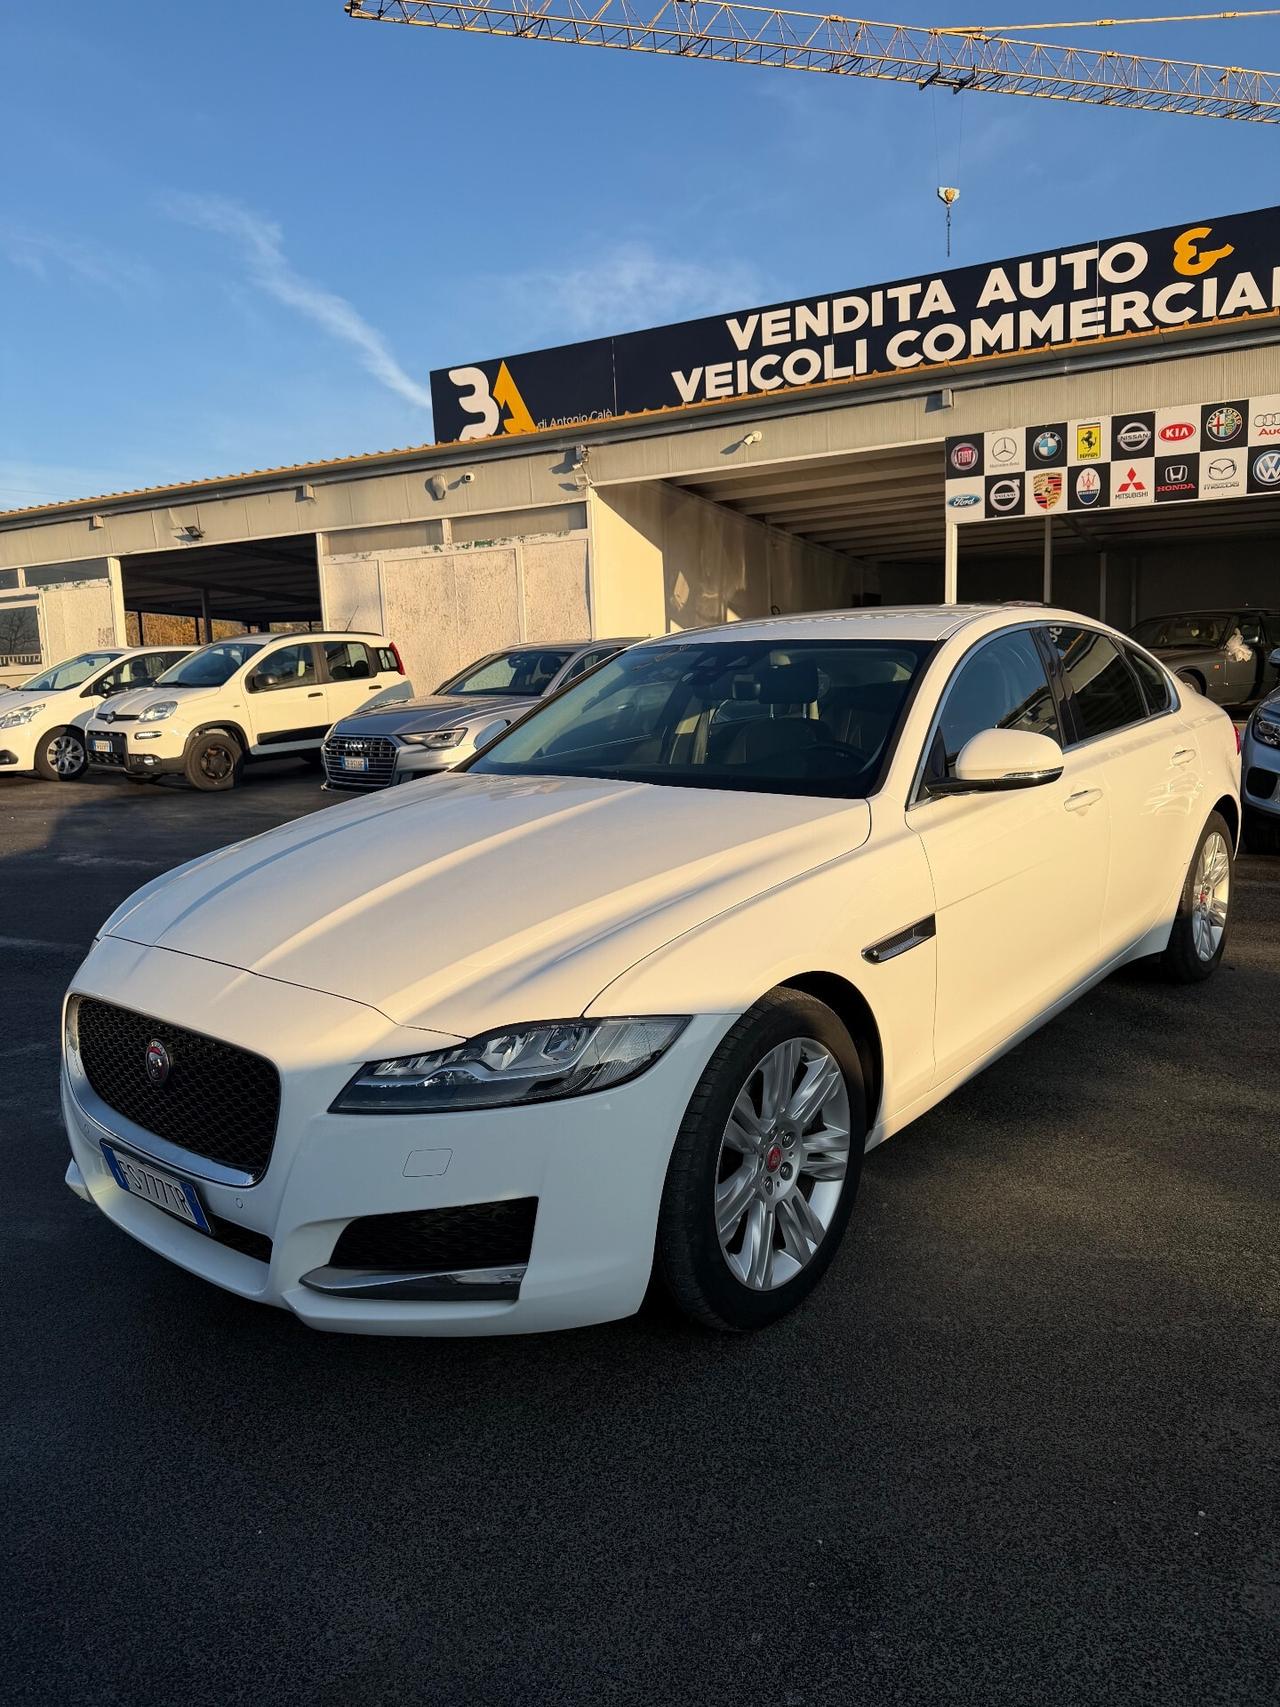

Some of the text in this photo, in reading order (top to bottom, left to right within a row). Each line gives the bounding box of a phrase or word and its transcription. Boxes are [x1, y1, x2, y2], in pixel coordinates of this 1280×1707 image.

[725, 227, 1235, 351] VENDITA AUTO &
[671, 266, 1280, 402] VEICOLI COMMERCIA
[550, 413, 587, 427] Antonio
[1119, 432, 1150, 441] NISSAN
[1165, 427, 1189, 438] KIA
[958, 450, 973, 463] FIAT
[1156, 483, 1196, 492] HONDA
[953, 496, 975, 506] Ford
[1115, 491, 1149, 500] MITSUBISHI
